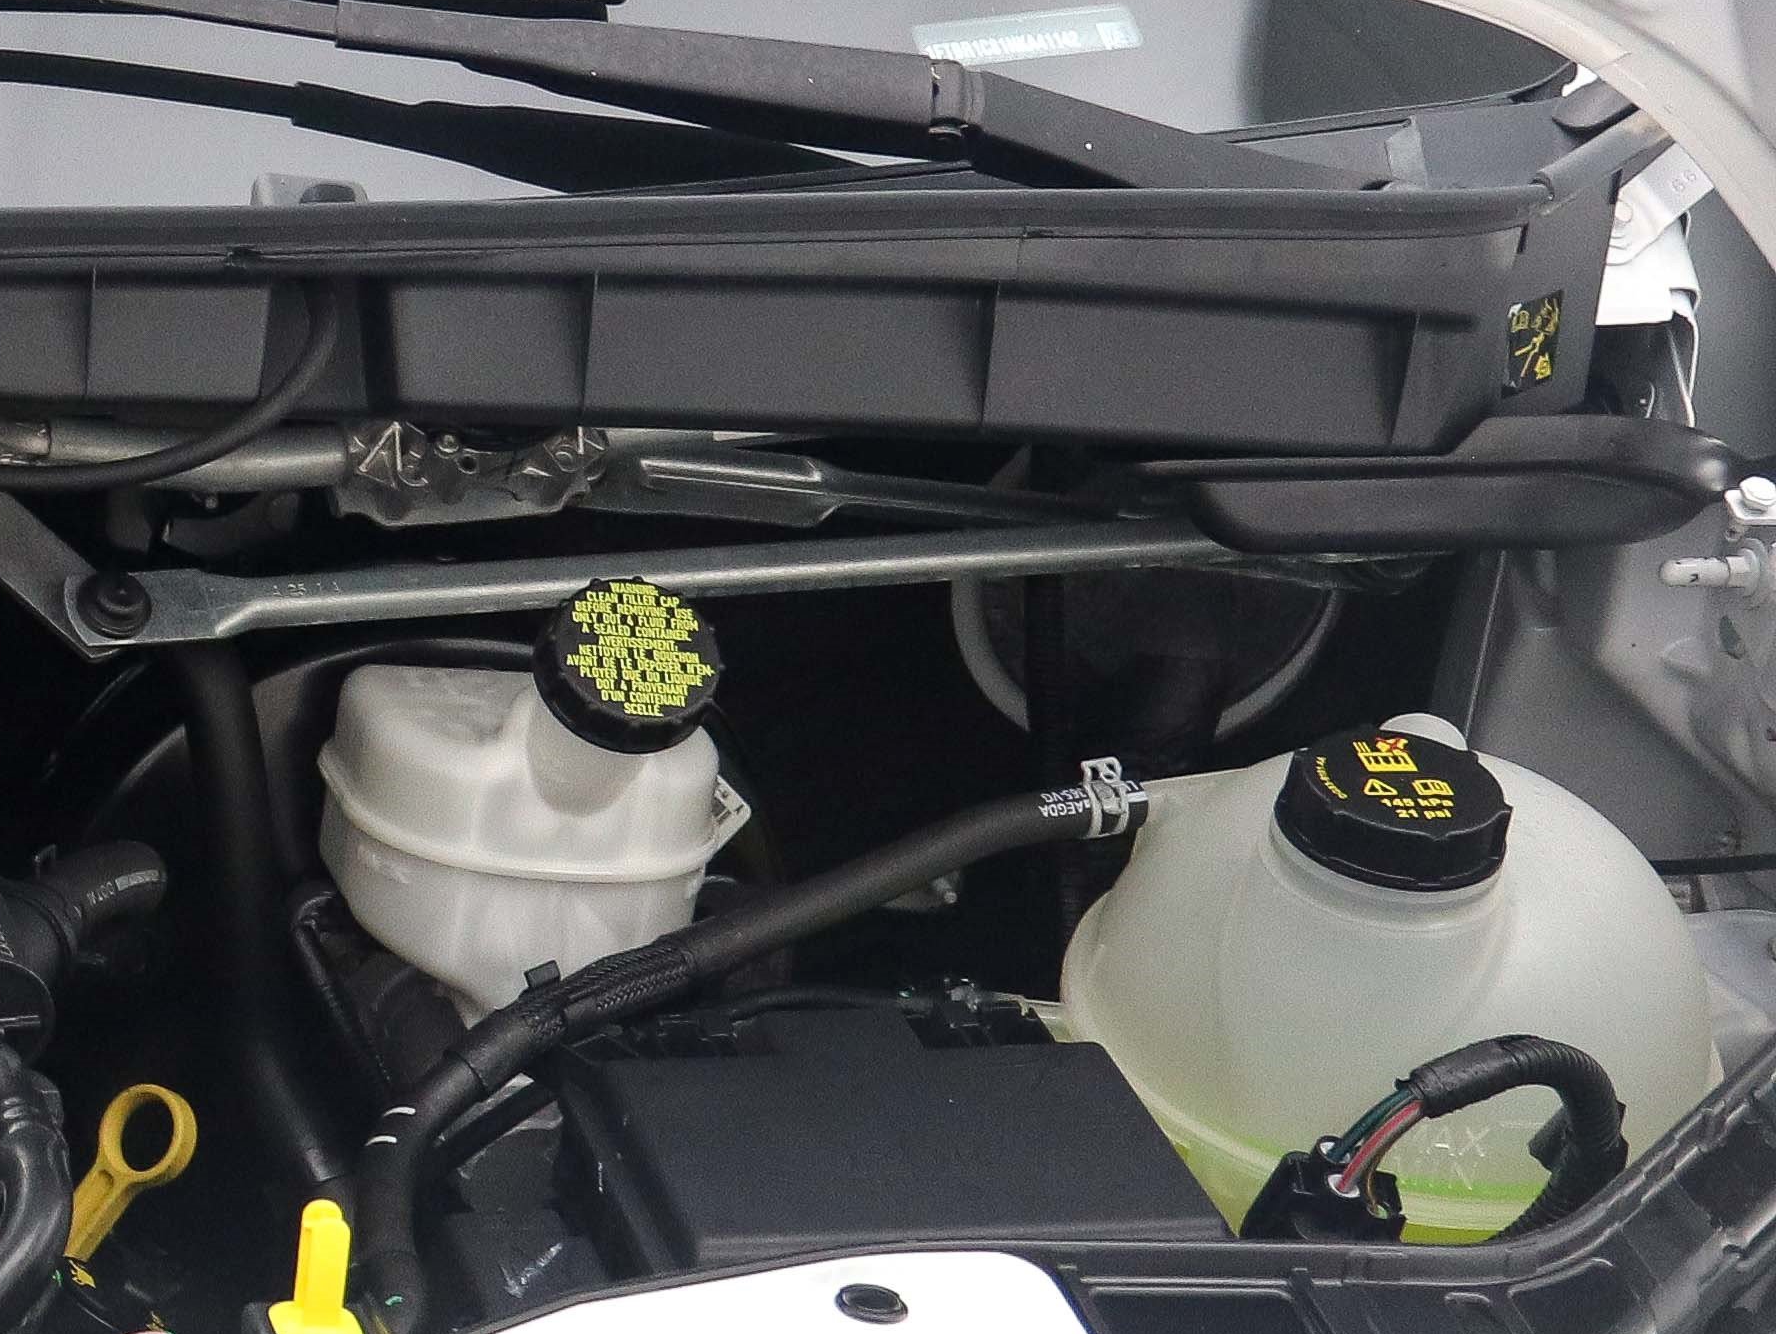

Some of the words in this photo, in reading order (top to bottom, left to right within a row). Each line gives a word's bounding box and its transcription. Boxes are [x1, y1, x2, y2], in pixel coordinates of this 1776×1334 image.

[586, 591, 618, 603] CLEAN
[623, 594, 655, 606] FILLER
[660, 596, 679, 608] CAP
[575, 601, 611, 613] BEFORE
[674, 608, 693, 620] USE
[572, 611, 597, 623] ONLY
[603, 614, 620, 624] DOT
[627, 616, 634, 626] 4
[639, 617, 666, 628] FLUID
[671, 618, 699, 631] FROM
[582, 623, 589, 633] A
[594, 624, 630, 637] SEALED
[567, 654, 598, 666] AVANT
[603, 657, 616, 668] DE
[621, 659, 633, 669] LE
[579, 644, 628, 658] NETTOYER
[634, 648, 646, 659] LE
[653, 650, 700, 664] BOUCHON
[580, 666, 618, 679] PLOYER
[622, 669, 642, 681] QUE
[647, 672, 659, 682] DU
[665, 672, 703, 686] LIQUIDE
[596, 679, 615, 689] DOT
[620, 680, 627, 691] 4
[632, 681, 688, 696] PROVENANT
[630, 692, 686, 707] CONTENANT
[1395, 809, 1419, 818] 21
[1423, 809, 1452, 820] psi
